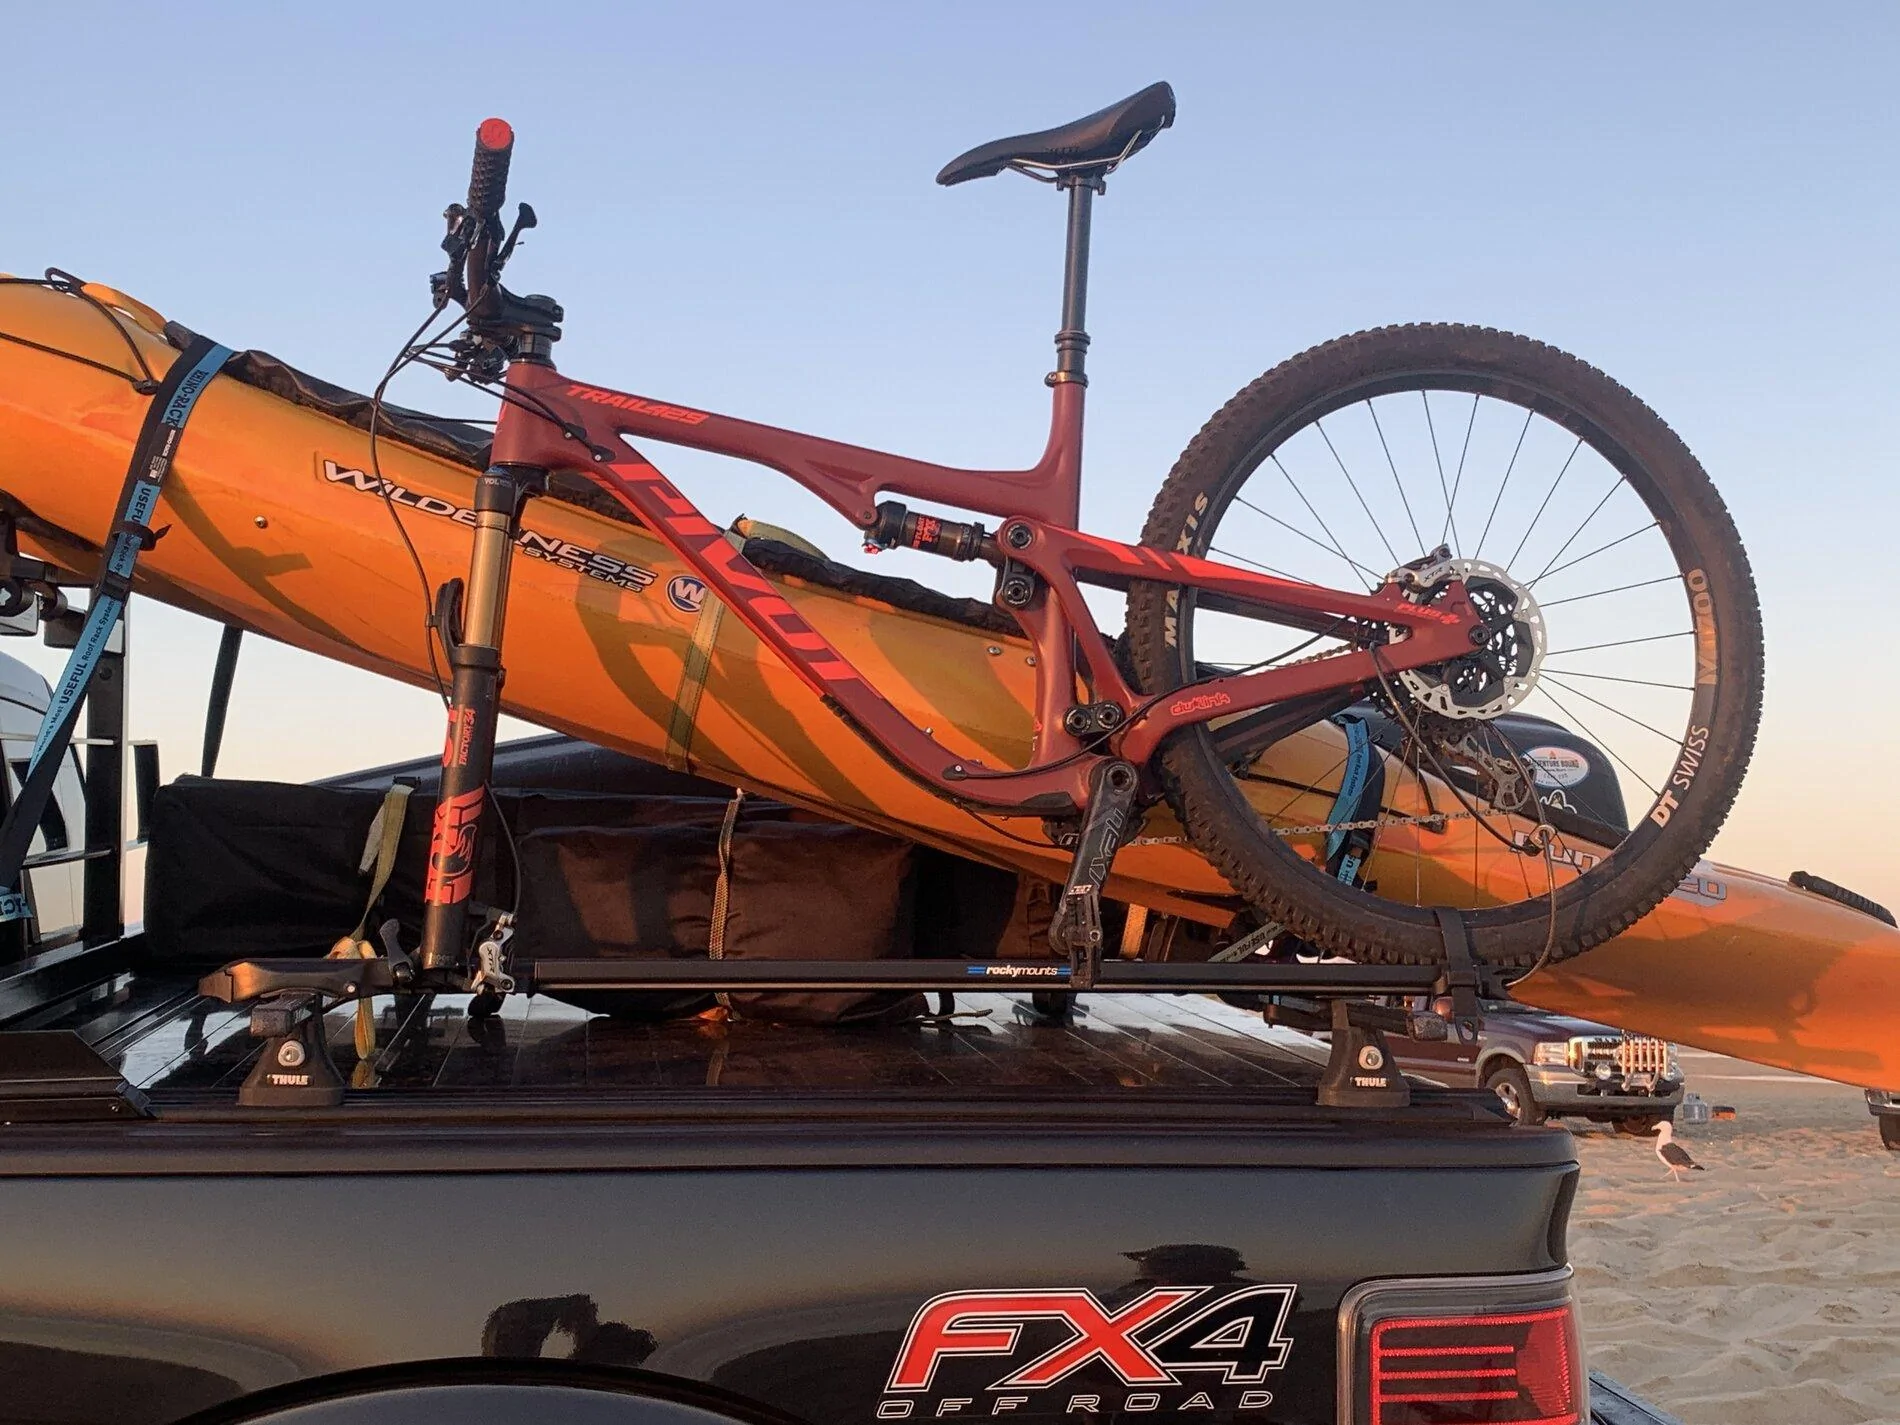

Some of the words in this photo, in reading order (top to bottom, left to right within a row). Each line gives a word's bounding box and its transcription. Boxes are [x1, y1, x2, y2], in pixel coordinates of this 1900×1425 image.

[131, 487, 151, 522] USEFU
[323, 459, 658, 585] WILDENESS
[523, 546, 644, 593] SYSTEMS
[1164, 492, 1208, 648] MAXIS
[60, 662, 88, 704] USEFUL
[82, 641, 95, 662] Roof
[90, 625, 104, 644] Rack
[1650, 789, 1679, 828] DT
[1673, 724, 1709, 790] SWISS
[985, 964, 1059, 978] rockymounts
[271, 1074, 309, 1086] THULE
[1354, 1076, 1387, 1088] THULE
[885, 1283, 1298, 1392] FX4
[877, 1395, 1029, 1419] OFF
[1066, 1391, 1274, 1414] ROAD
